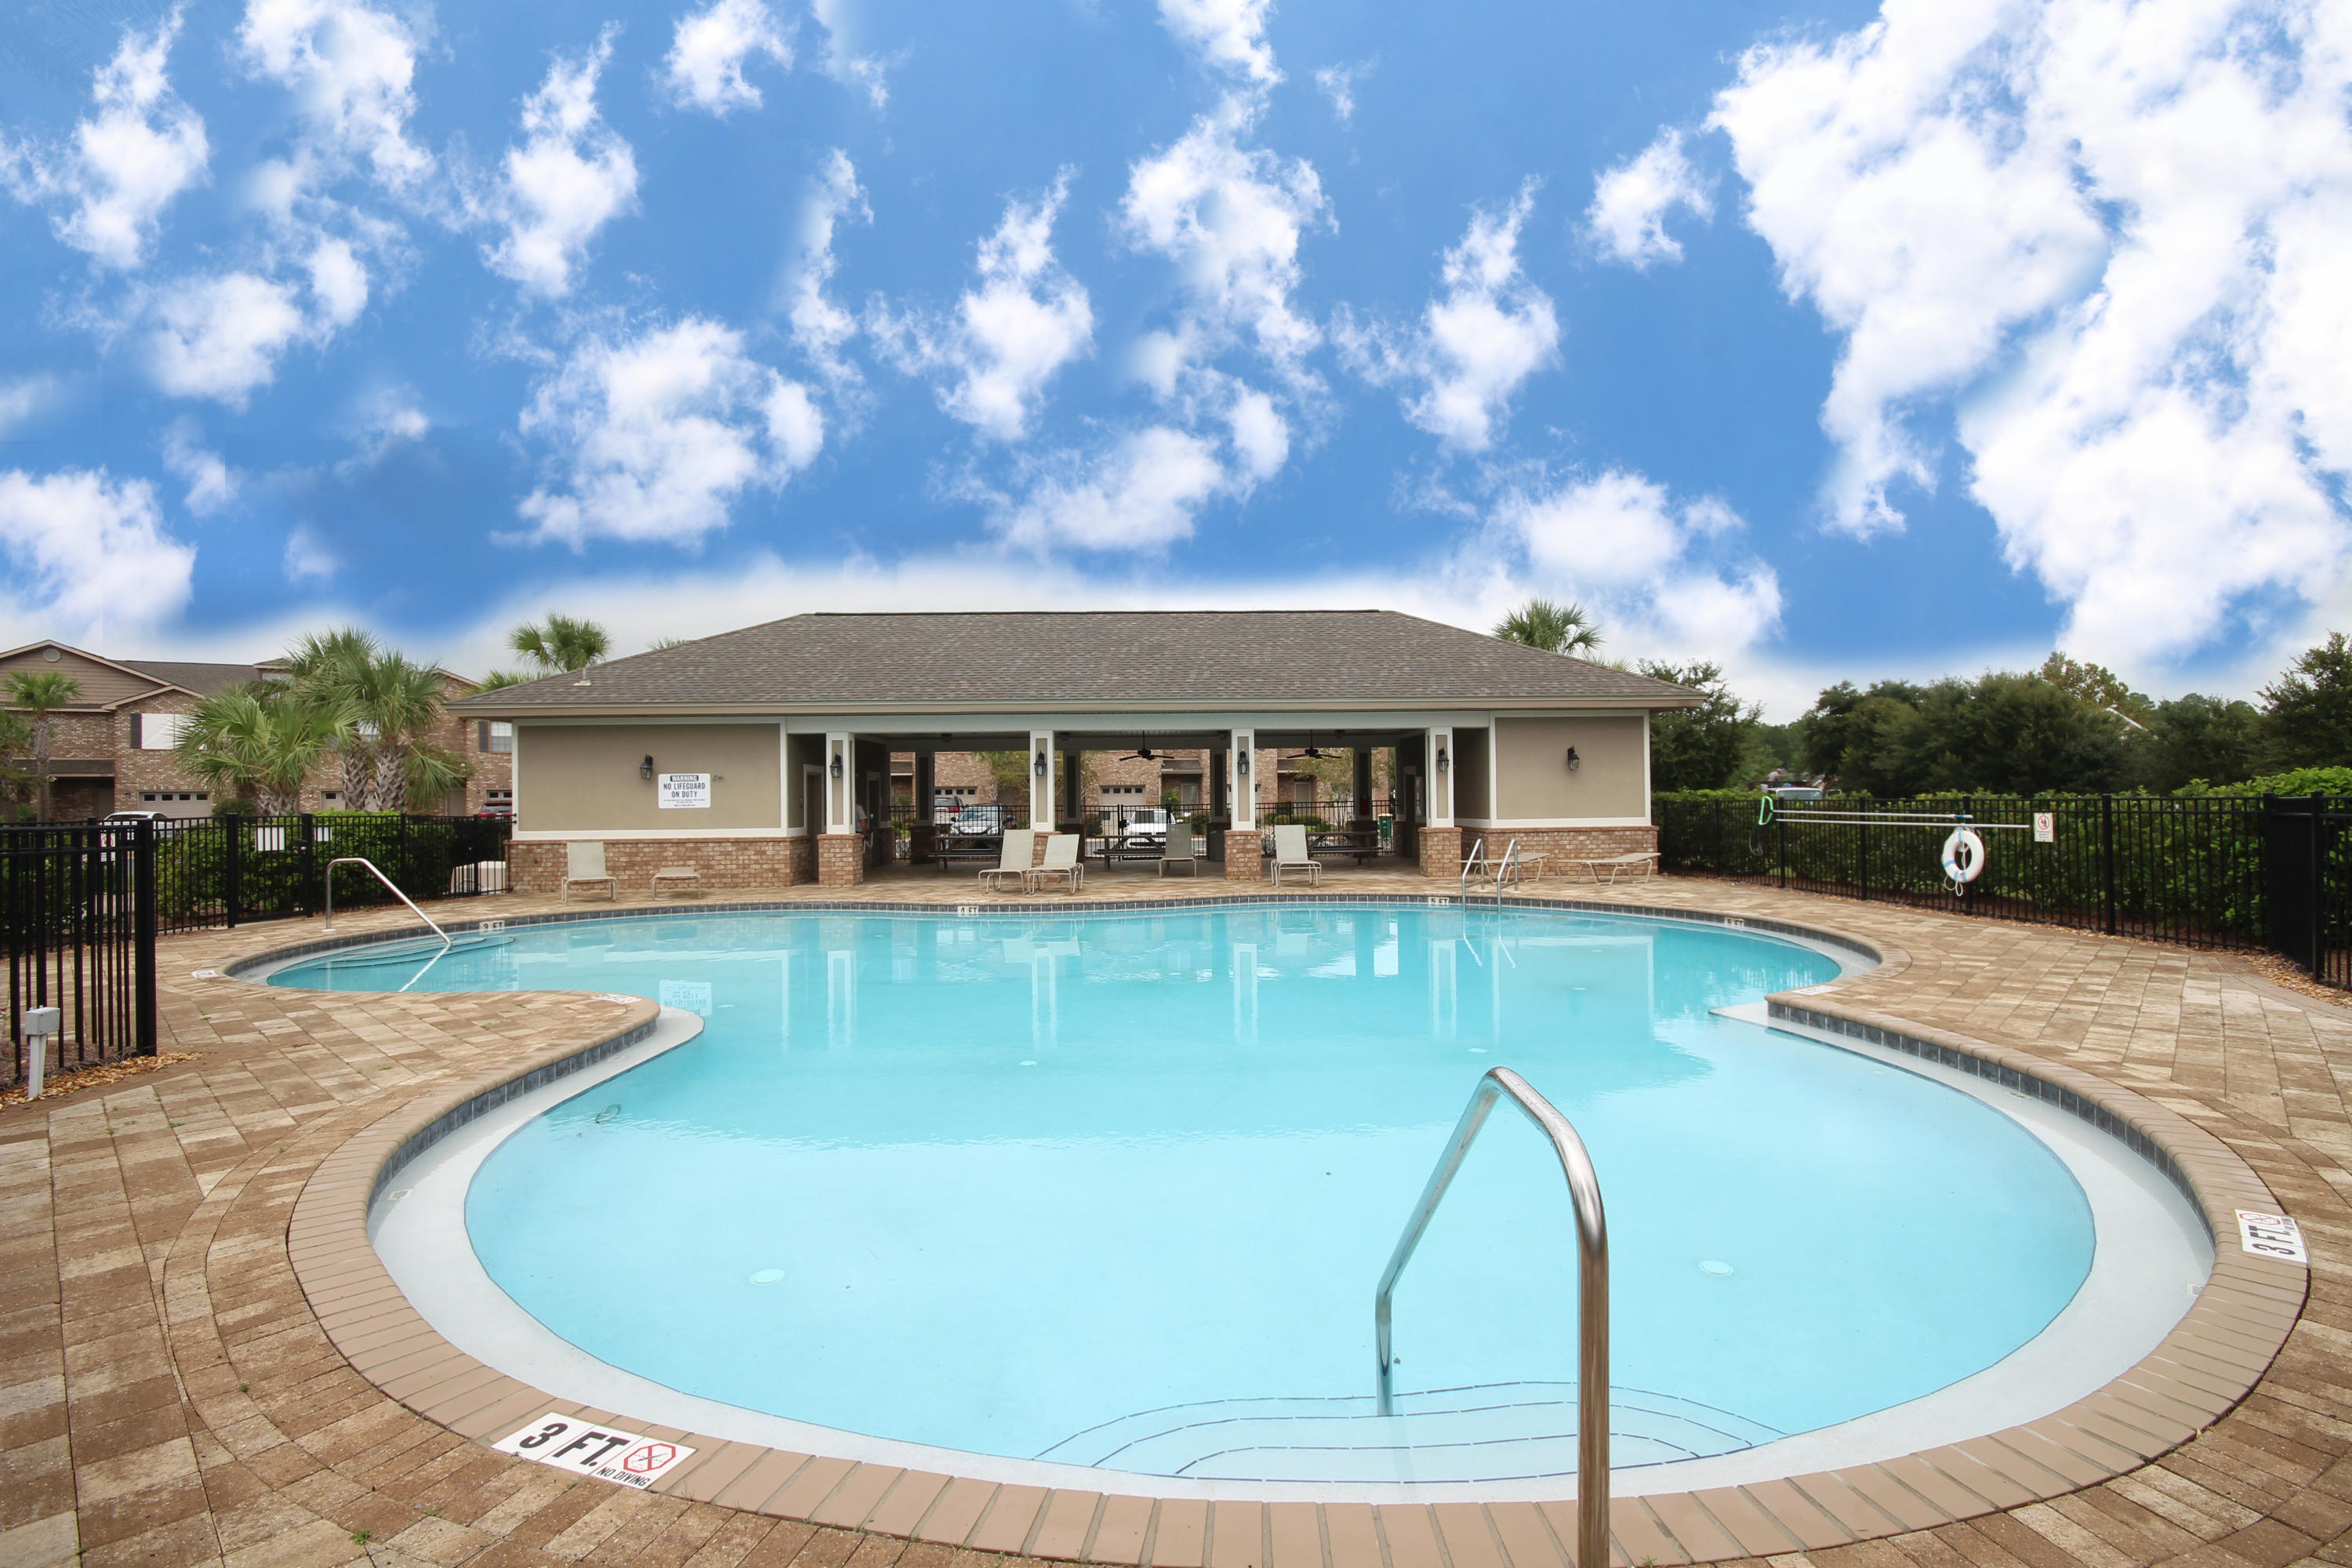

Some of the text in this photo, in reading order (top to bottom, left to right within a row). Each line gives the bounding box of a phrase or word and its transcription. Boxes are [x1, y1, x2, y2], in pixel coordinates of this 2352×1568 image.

[2252, 1243, 2296, 1255] 3
[519, 1422, 631, 1467] 3 FT.
[596, 1467, 651, 1486] NO DIVING
